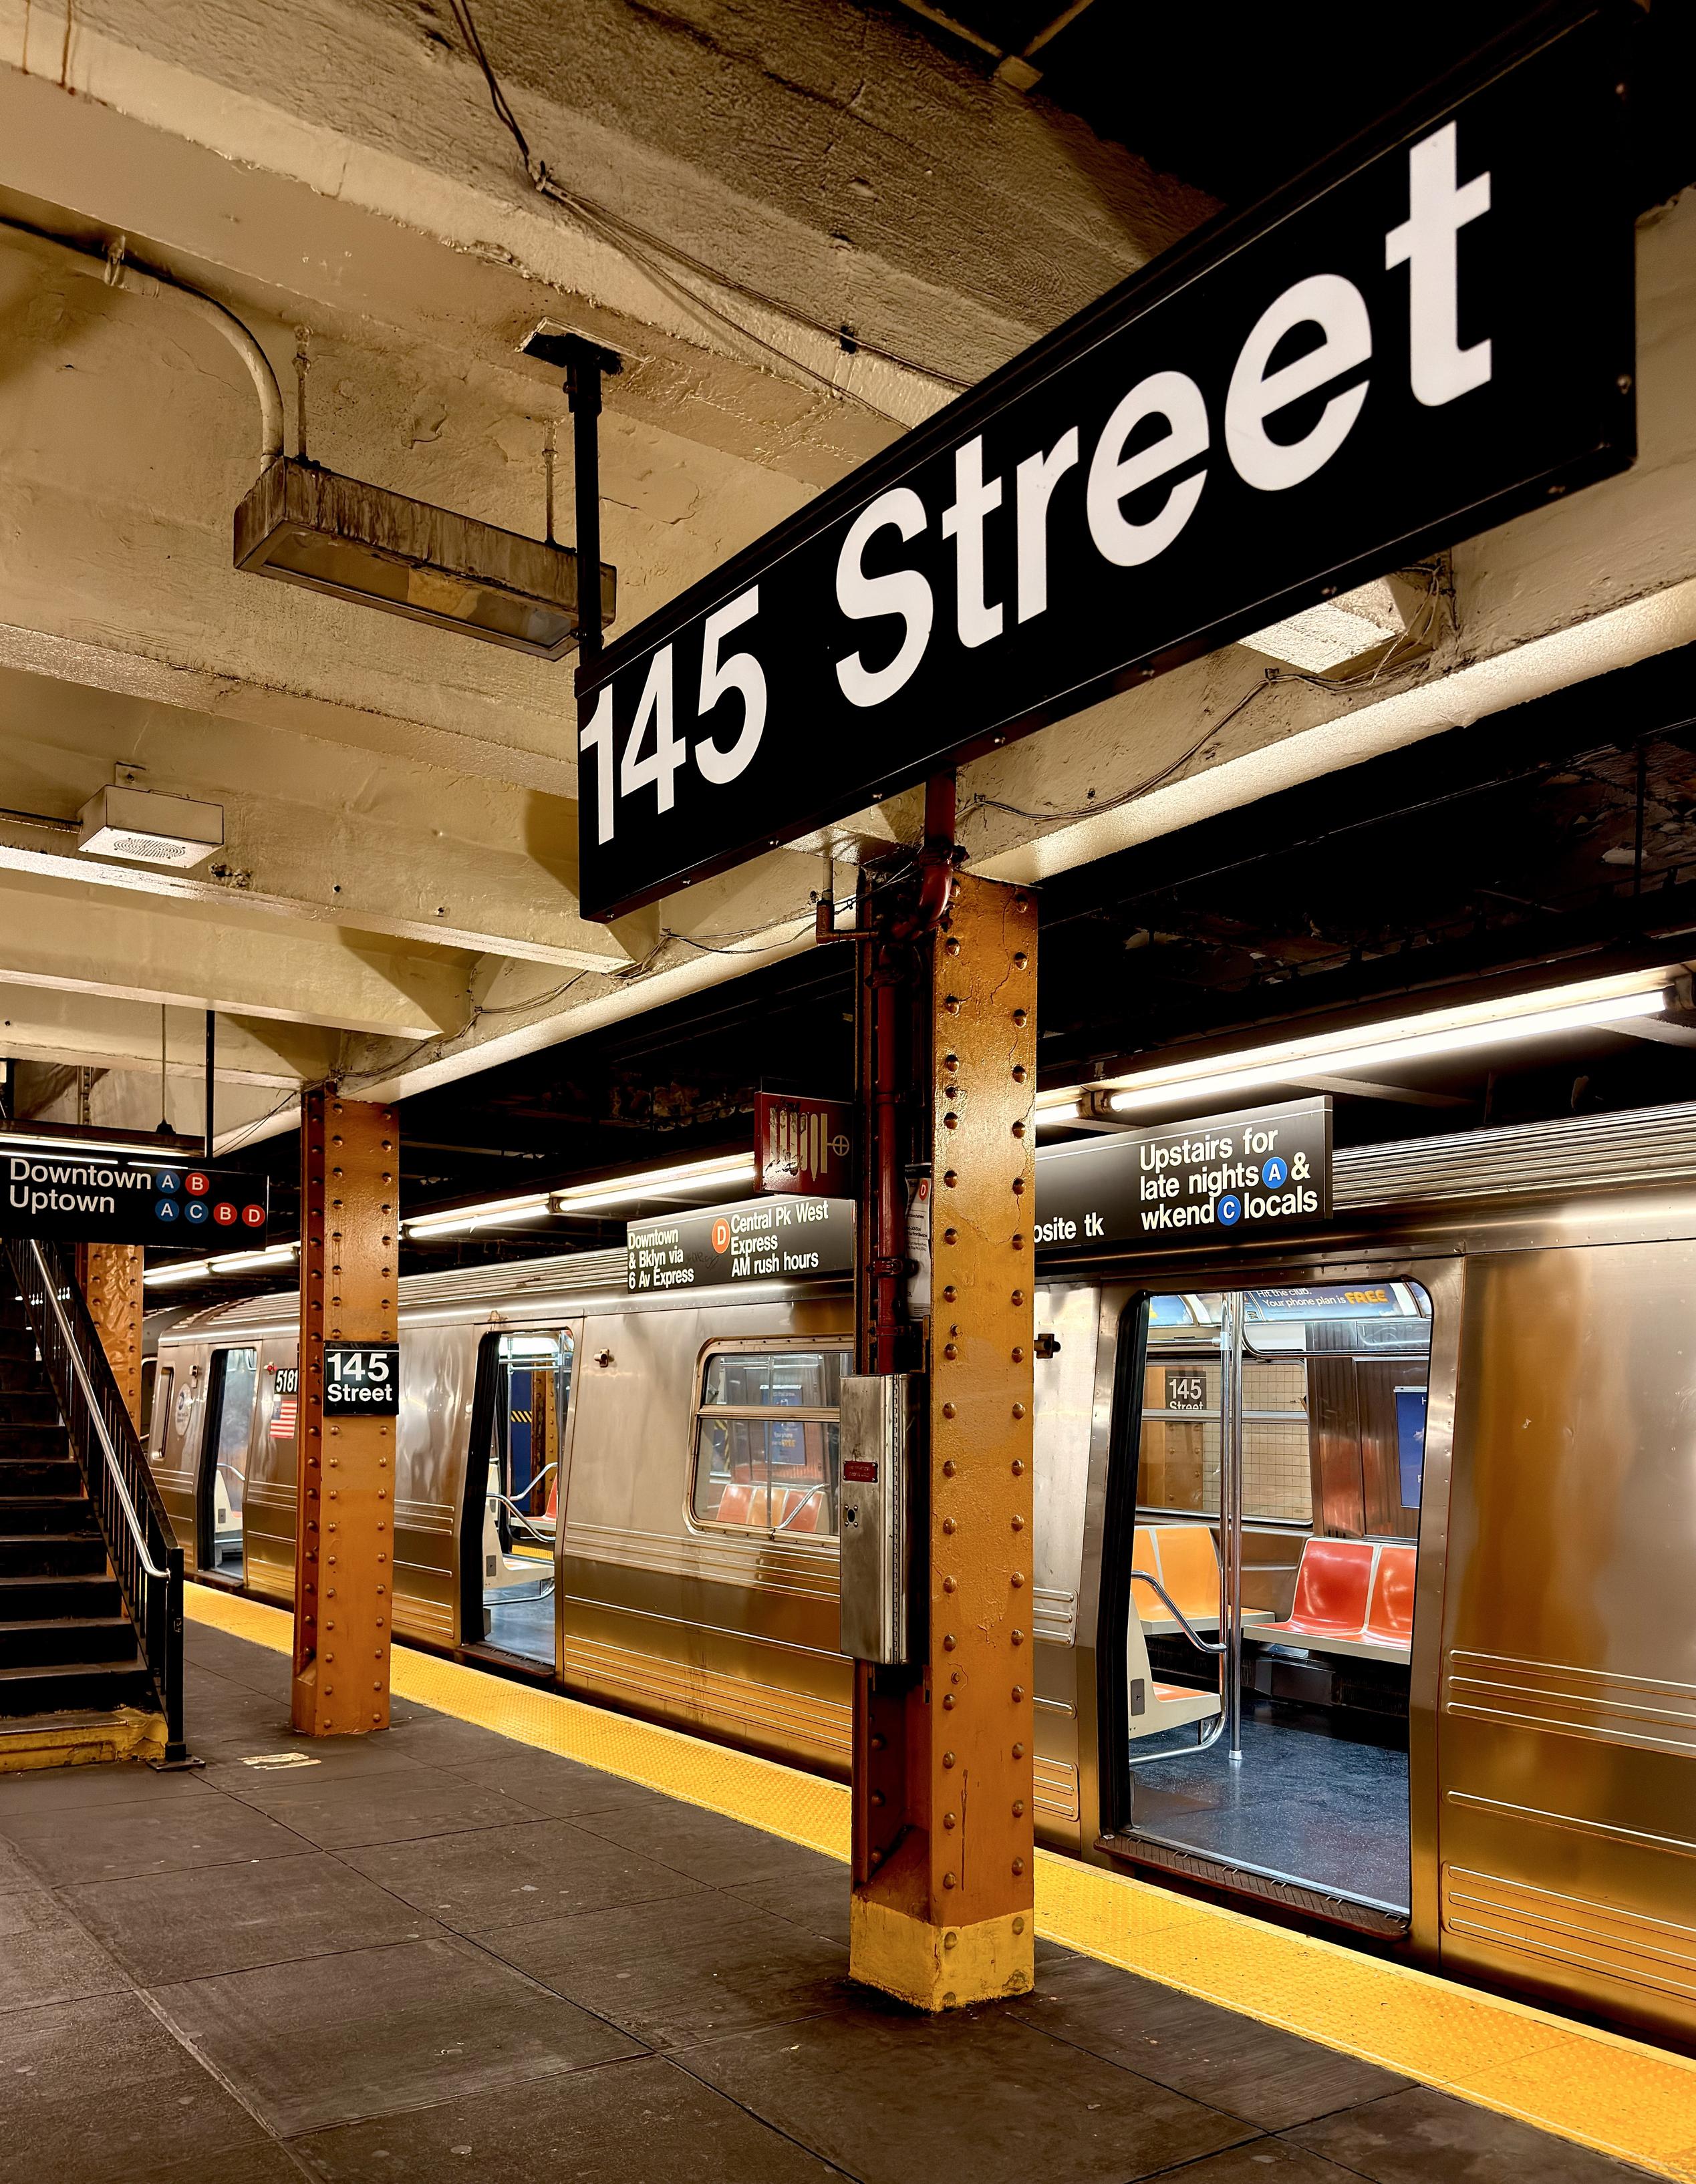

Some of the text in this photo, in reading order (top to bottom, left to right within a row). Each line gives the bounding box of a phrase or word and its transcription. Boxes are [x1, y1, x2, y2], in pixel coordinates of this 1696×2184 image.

[580, 120, 1492, 845] 145 Street
[1140, 1127, 1278, 1174] Upstairs for
[10, 1158, 203, 1191] Downtown A B
[1140, 1152, 1310, 1201] late nights A &
[9, 1185, 260, 1223] Uptown A C B D
[1141, 1185, 1318, 1231] wkend C locals
[731, 1201, 829, 1234] Central Pk West
[1084, 1212, 1105, 1237] tk
[628, 1229, 679, 1250] Downtown
[717, 1225, 726, 1245] D
[731, 1235, 778, 1257] Express
[628, 1253, 636, 1269] &
[640, 1249, 666, 1269] Bklyn
[669, 1245, 684, 1265] via
[731, 1258, 750, 1277] AM
[754, 1253, 780, 1274] rush
[783, 1251, 819, 1272] hours
[629, 1268, 694, 1289] 6 Av Express
[1262, 1289, 1389, 1308] Your phone plan is FREE
[1289, 1287, 1312, 1296] club.
[327, 1352, 390, 1382] 145
[276, 1370, 298, 1392] 5181
[327, 1384, 393, 1402] Street
[1169, 1378, 1202, 1400] 145
